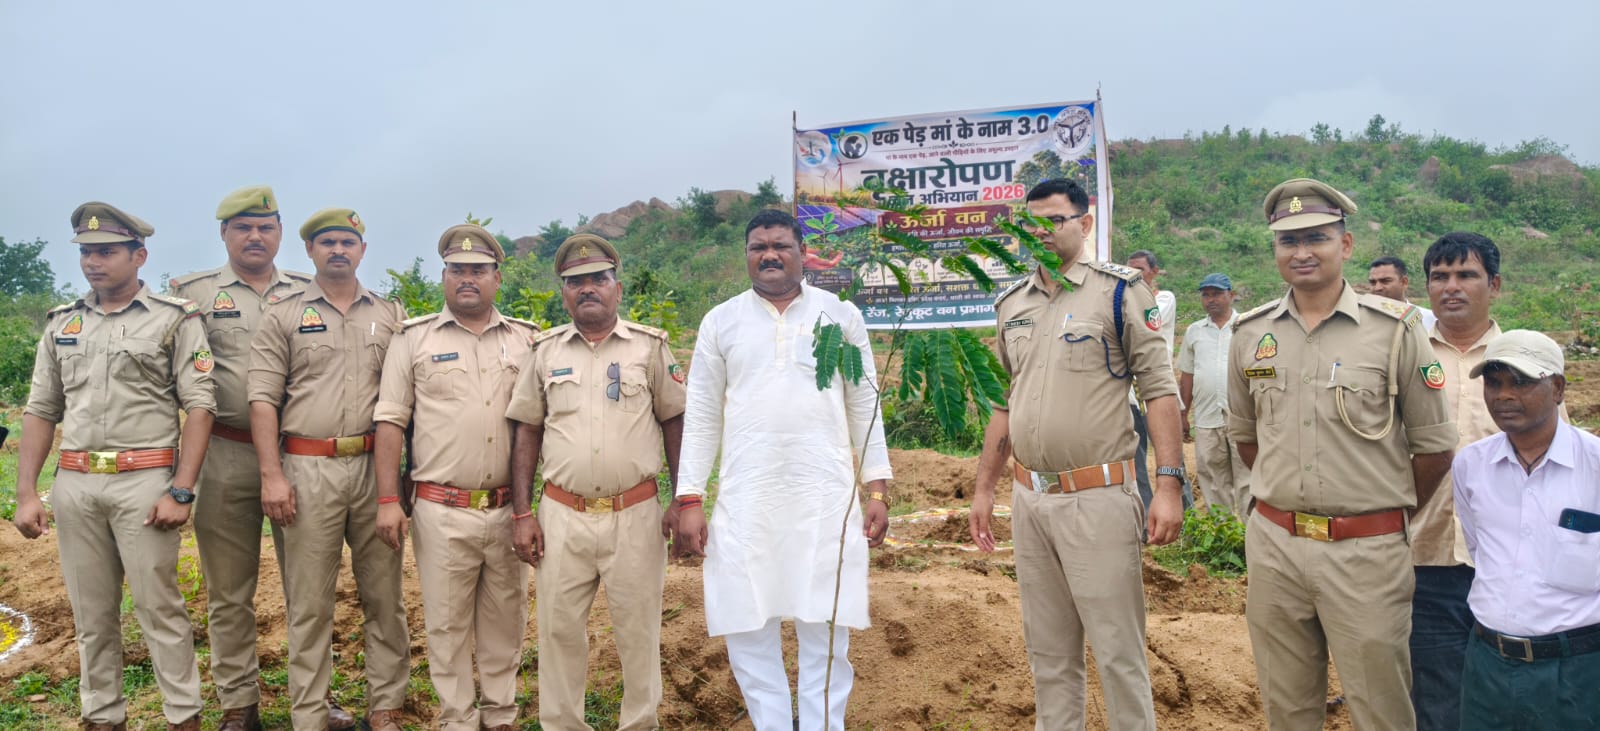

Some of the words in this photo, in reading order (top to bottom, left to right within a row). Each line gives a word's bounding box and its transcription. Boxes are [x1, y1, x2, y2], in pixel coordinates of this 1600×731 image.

[872, 128, 900, 145] एक
[903, 122, 927, 147] पेड़
[930, 119, 952, 141] मां
[956, 117, 974, 140] के
[977, 119, 1013, 138] नाम
[1017, 114, 1049, 136] 3.0
[919, 189, 978, 204] अभियान
[983, 184, 1025, 200] 2026
[900, 209, 945, 229] ऊर्जा
[955, 211, 987, 224] वन
[937, 306, 956, 315] वन
[960, 304, 995, 316] प्रभाग
